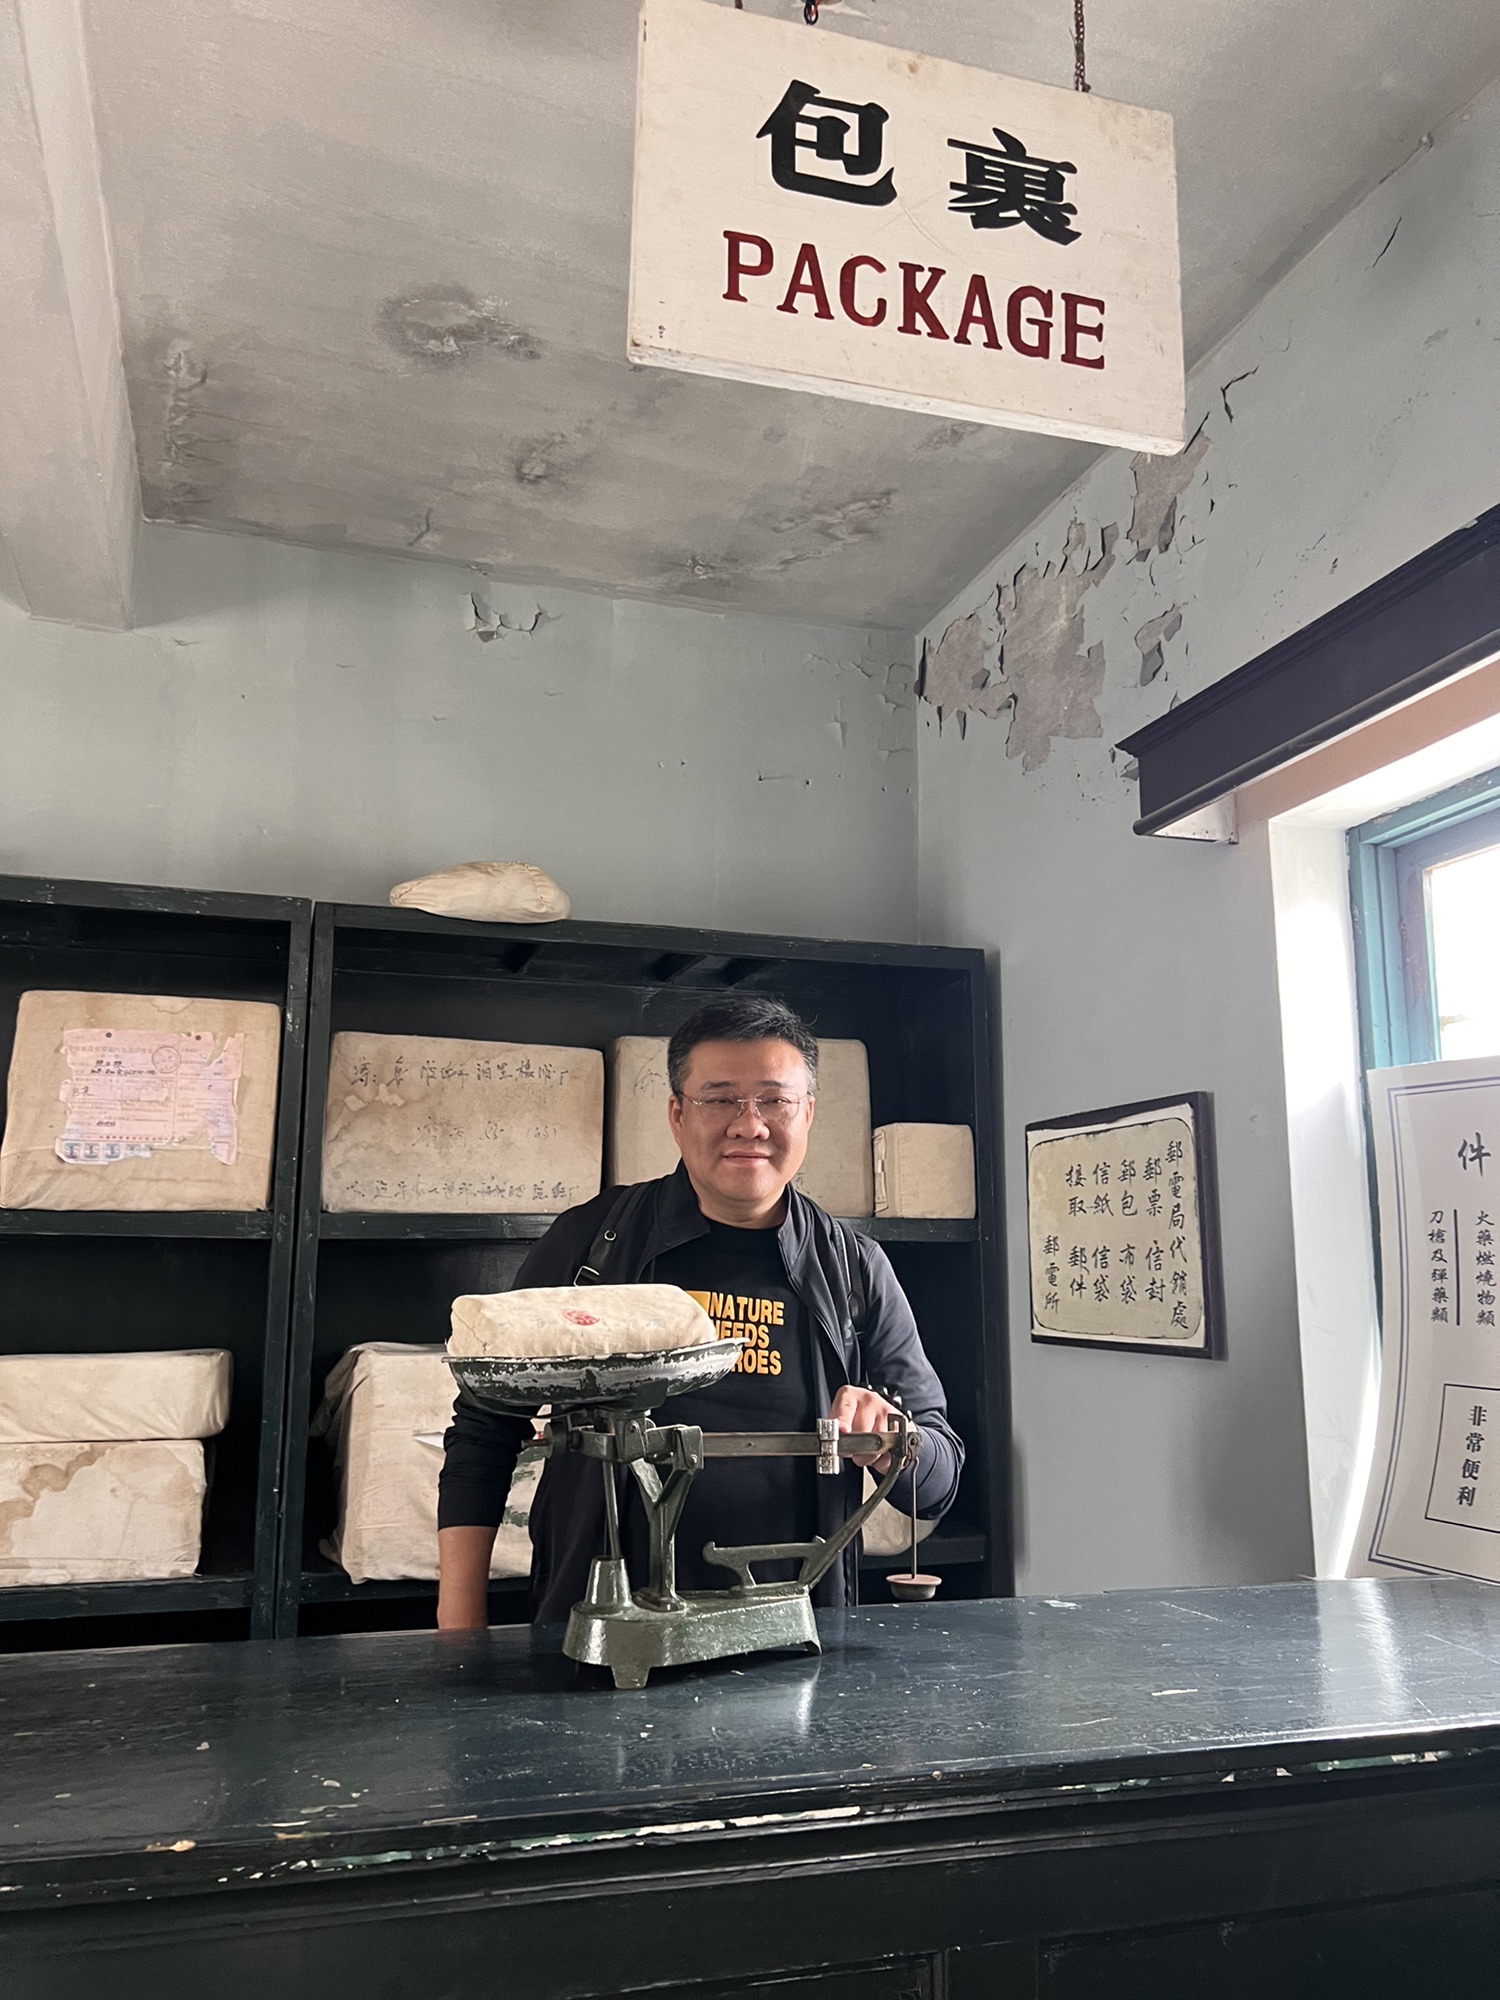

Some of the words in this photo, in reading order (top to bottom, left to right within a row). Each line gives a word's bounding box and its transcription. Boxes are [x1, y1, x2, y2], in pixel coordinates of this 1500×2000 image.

[756, 79, 1082, 246] 包裹
[721, 230, 1106, 370] PACKAGE
[1457, 1132, 1492, 1177] 件
[1065, 1164, 1088, 1217] 接取
[1091, 1162, 1115, 1217] 信紙
[1117, 1159, 1138, 1218] 郵包
[1143, 1157, 1163, 1217] 郵票
[1165, 1140, 1190, 1329] 郵電局代銷處
[1043, 1235, 1060, 1314] 郵電所
[1067, 1245, 1090, 1299] 郵件
[1091, 1245, 1111, 1303] 信袋
[1145, 1240, 1166, 1303] 信封
[1475, 1210, 1497, 1327] 火藥燃燒物類
[710, 1291, 785, 1326] NATURE
[1456, 1405, 1488, 1507] 非常便利
